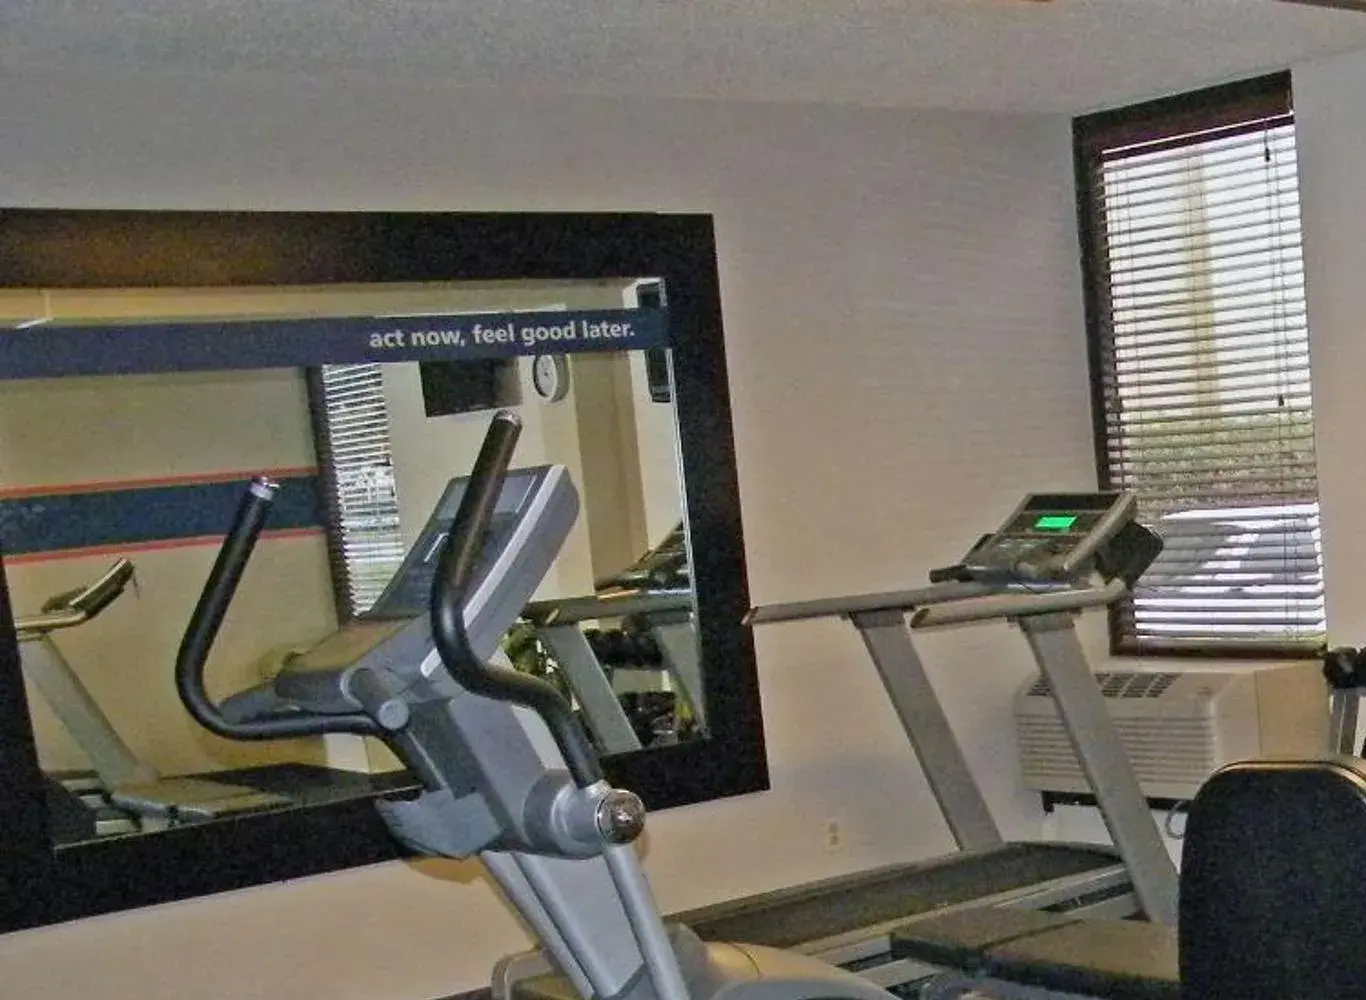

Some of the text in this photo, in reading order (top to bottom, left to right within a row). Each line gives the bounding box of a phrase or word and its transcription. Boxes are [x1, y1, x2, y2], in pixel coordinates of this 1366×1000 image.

[369, 319, 636, 348] act now, feel good later.
